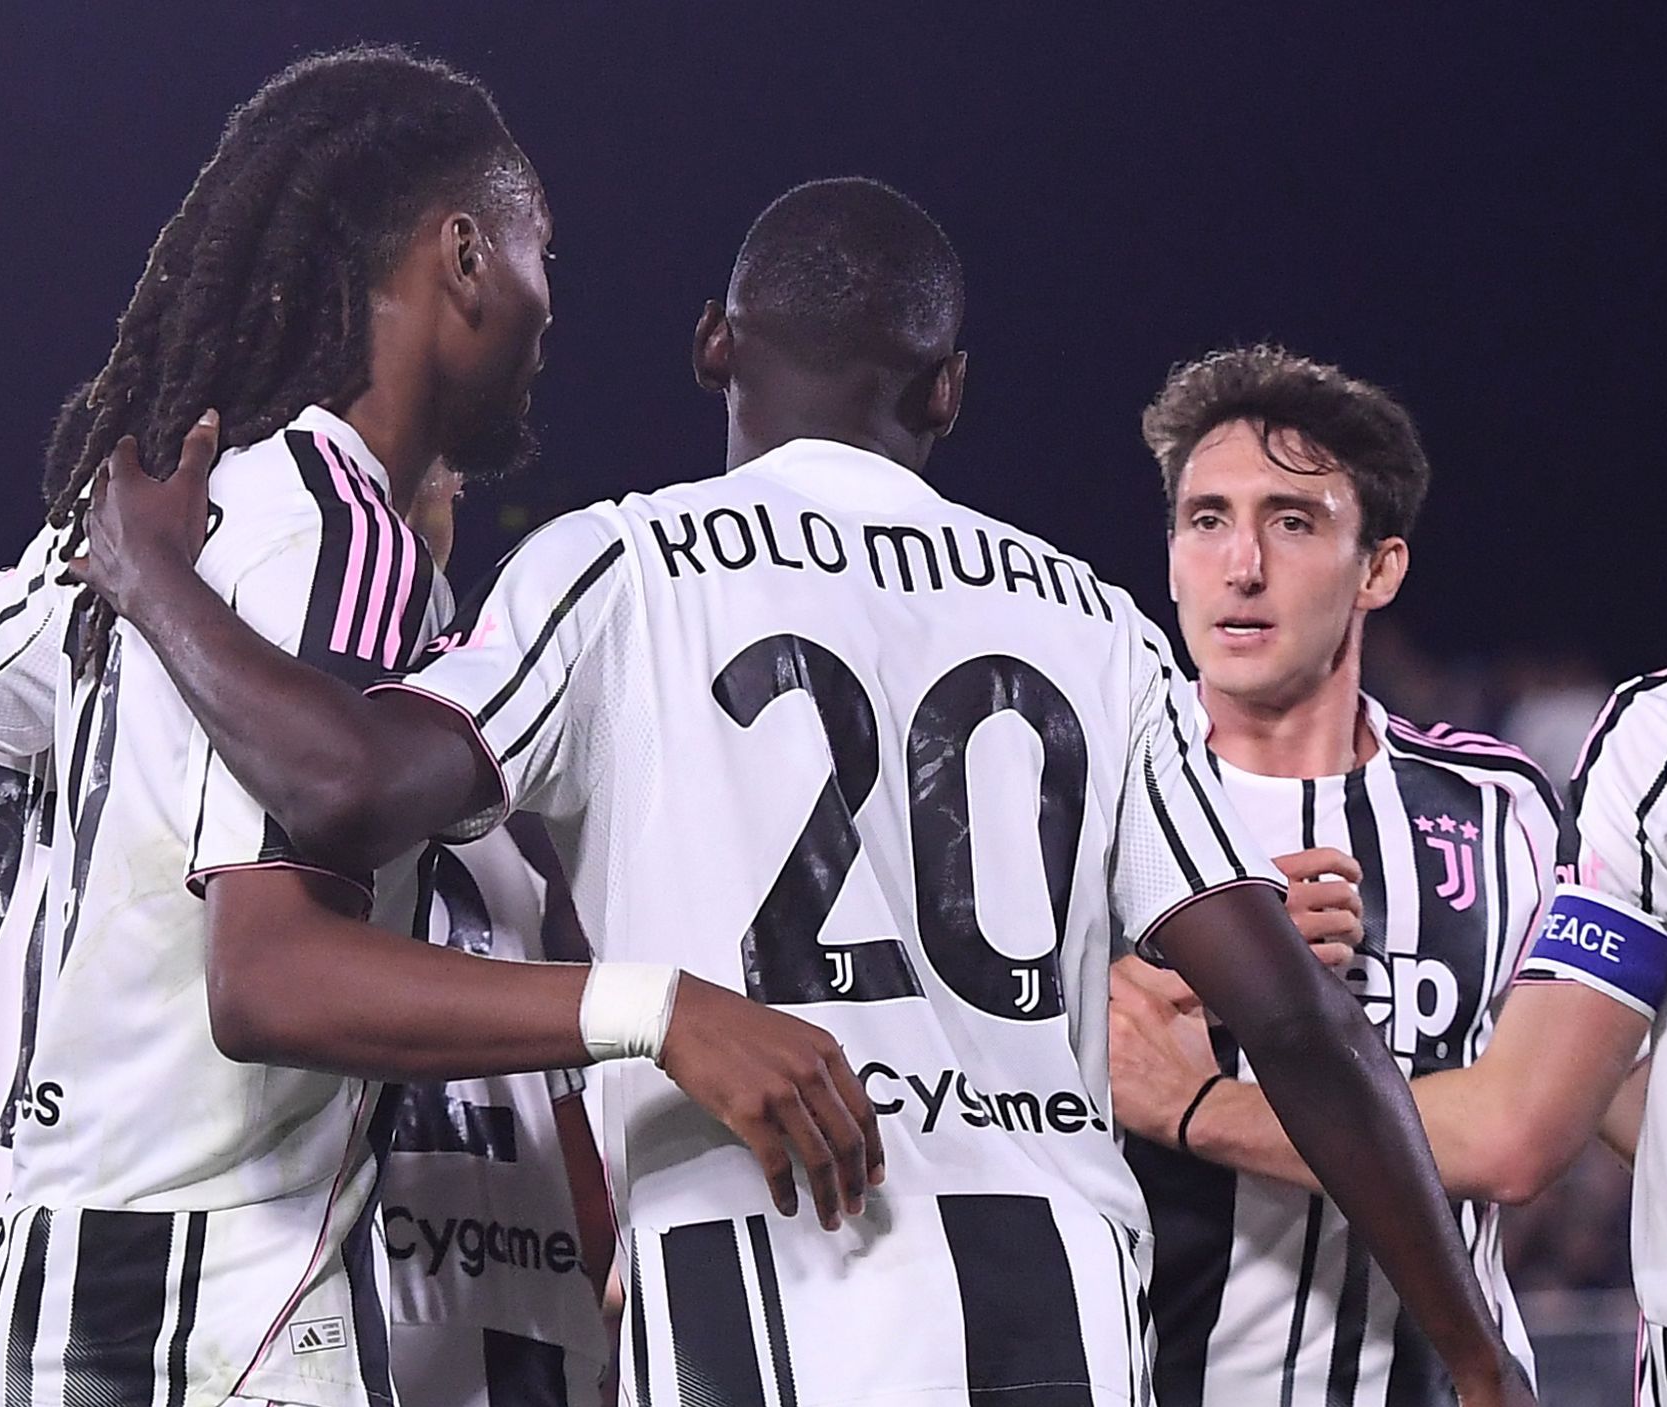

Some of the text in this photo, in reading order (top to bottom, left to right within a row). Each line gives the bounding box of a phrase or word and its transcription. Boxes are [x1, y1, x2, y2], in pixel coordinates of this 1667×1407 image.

[650, 504, 1114, 622] KOLO MUANI
[710, 632, 1089, 1024] 20
[382, 1205, 586, 1278] Cygame
